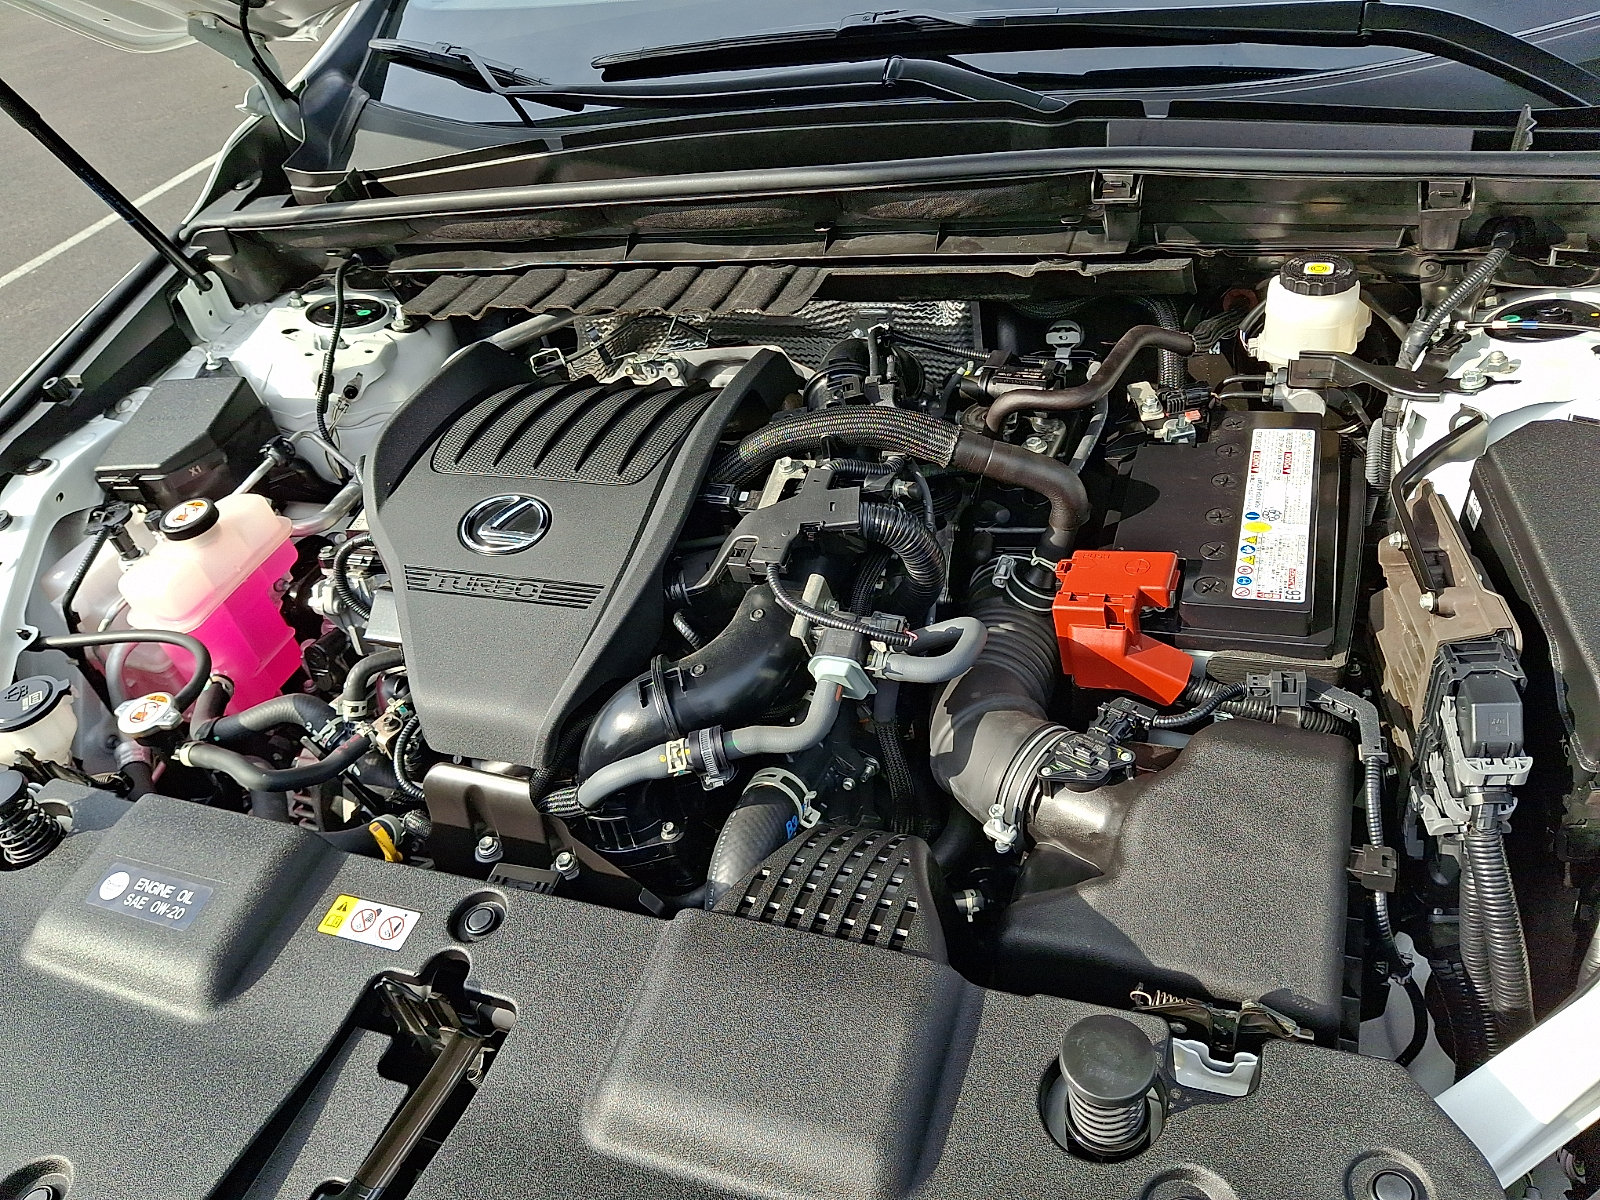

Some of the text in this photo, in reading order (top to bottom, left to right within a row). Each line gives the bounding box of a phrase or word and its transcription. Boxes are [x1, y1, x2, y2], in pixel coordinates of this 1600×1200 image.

[188, 464, 202, 477] X1
[434, 572, 539, 598] TURBO
[133, 877, 177, 899] ENGINE
[176, 889, 196, 905] OIL
[123, 893, 186, 920] SAE 0W-20
